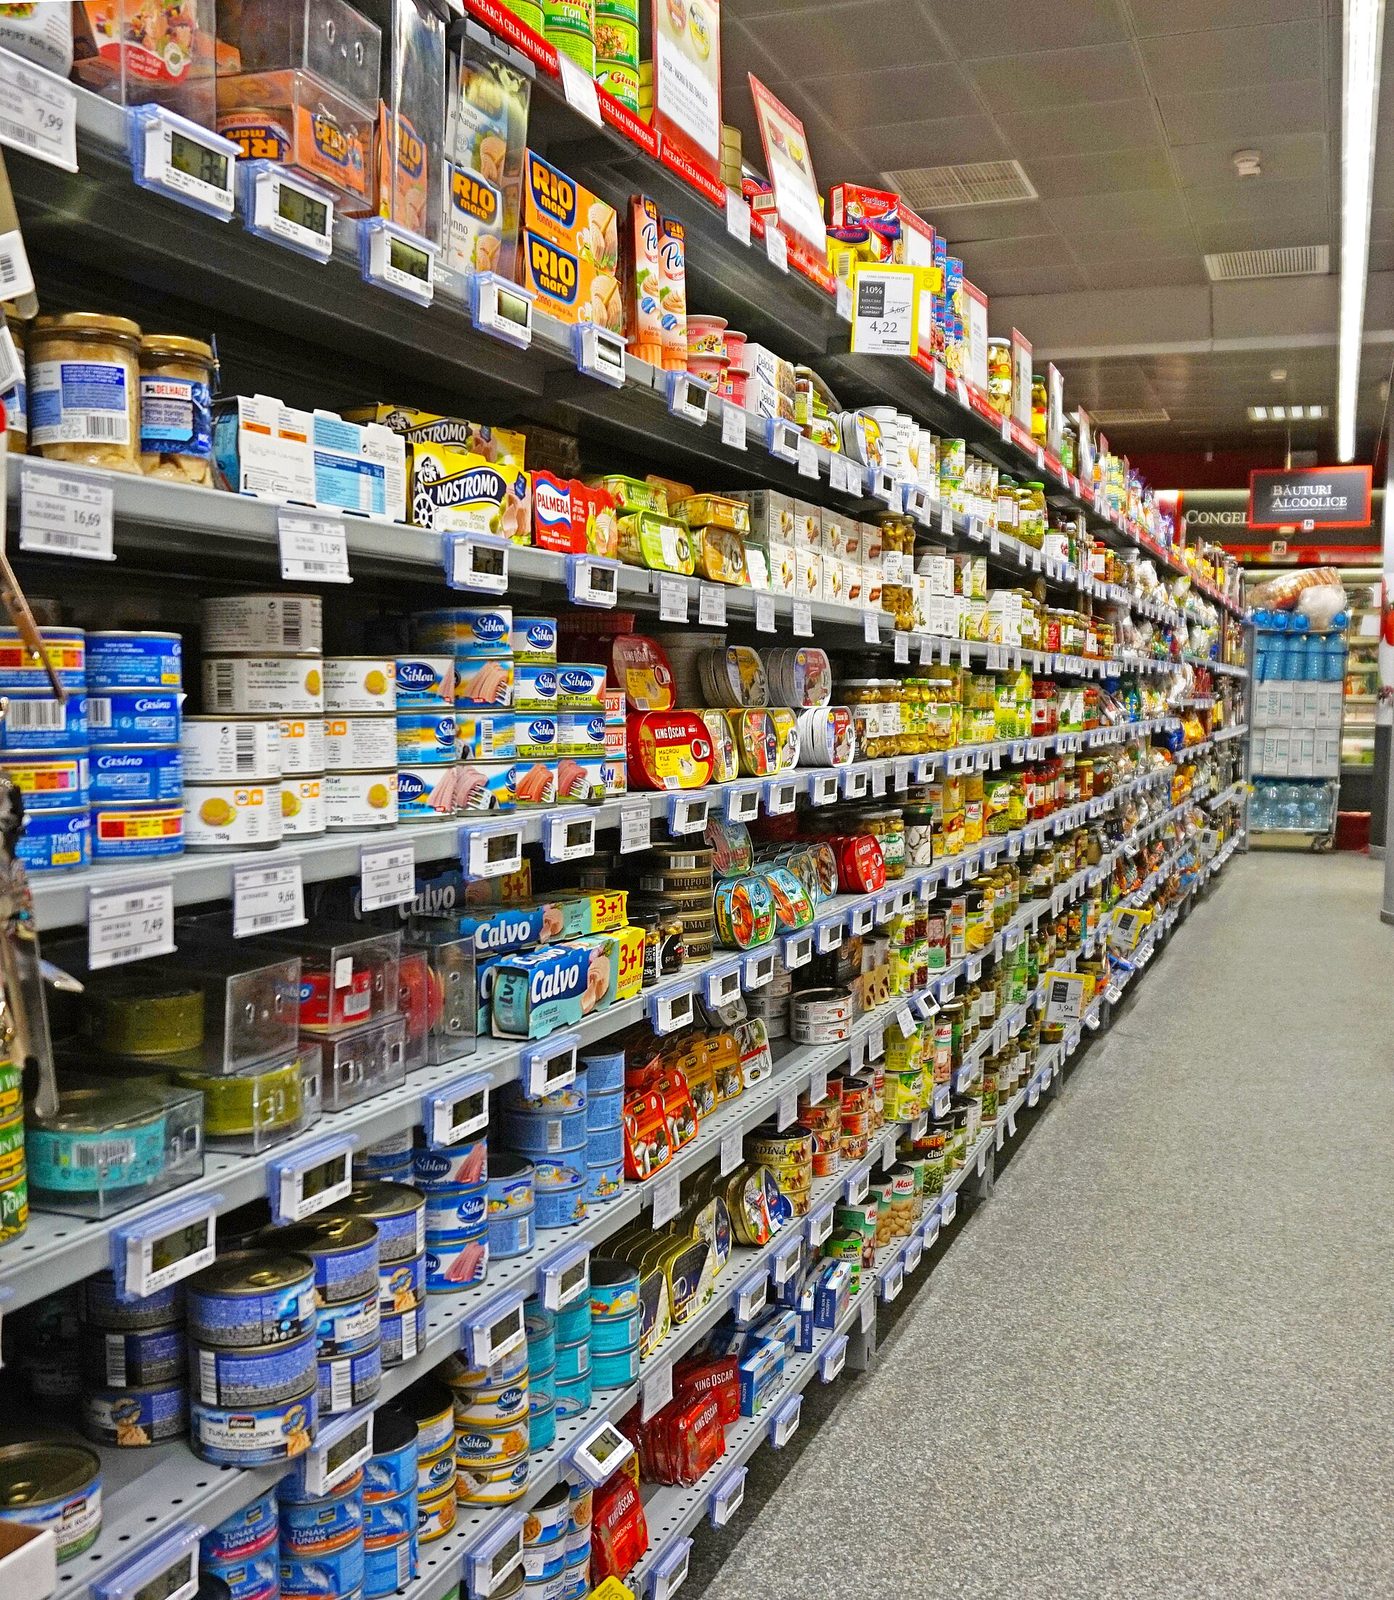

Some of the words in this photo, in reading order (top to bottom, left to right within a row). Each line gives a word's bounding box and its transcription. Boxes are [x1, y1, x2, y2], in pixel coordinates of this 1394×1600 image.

[503, 20, 521, 38] CELE
[36, 108, 64, 130] 7,99
[453, 171, 496, 212] RIO
[532, 161, 574, 211] RIO
[460, 198, 488, 219] mare
[541, 194, 566, 219] mare
[532, 241, 575, 286] RIO
[540, 274, 568, 297] mare
[861, 285, 883, 296] -10%
[869, 320, 898, 334] 4,22
[155, 385, 189, 397] DELHAIZE
[408, 422, 467, 443] NOSTROMO
[436, 471, 498, 506] NOSTROMO
[1273, 484, 1332, 496] BĂUTURI
[537, 492, 570, 515] PALMERA
[1272, 496, 1348, 508] ALCOOLICE
[73, 510, 101, 528] 16,69
[477, 614, 505, 633] Siblou
[399, 665, 434, 683] Siblou
[560, 671, 593, 687] Siblou
[135, 698, 171, 712] Casino
[655, 727, 668, 740] KING
[668, 726, 687, 740] OSCAR
[97, 755, 143, 769] Casino
[398, 781, 422, 795] blou
[399, 885, 457, 919] Calvo
[595, 894, 624, 918] 3+1
[474, 918, 531, 950] Calvo
[619, 937, 644, 976] 3+1
[530, 963, 580, 1004] Calvo
[415, 1155, 449, 1173] Siblou
[711, 1370, 733, 1387] OSCAR
[462, 1437, 490, 1449] Siblou
[617, 1490, 635, 1517] OSCAR
[612, 1520, 634, 1545] SARDINE
